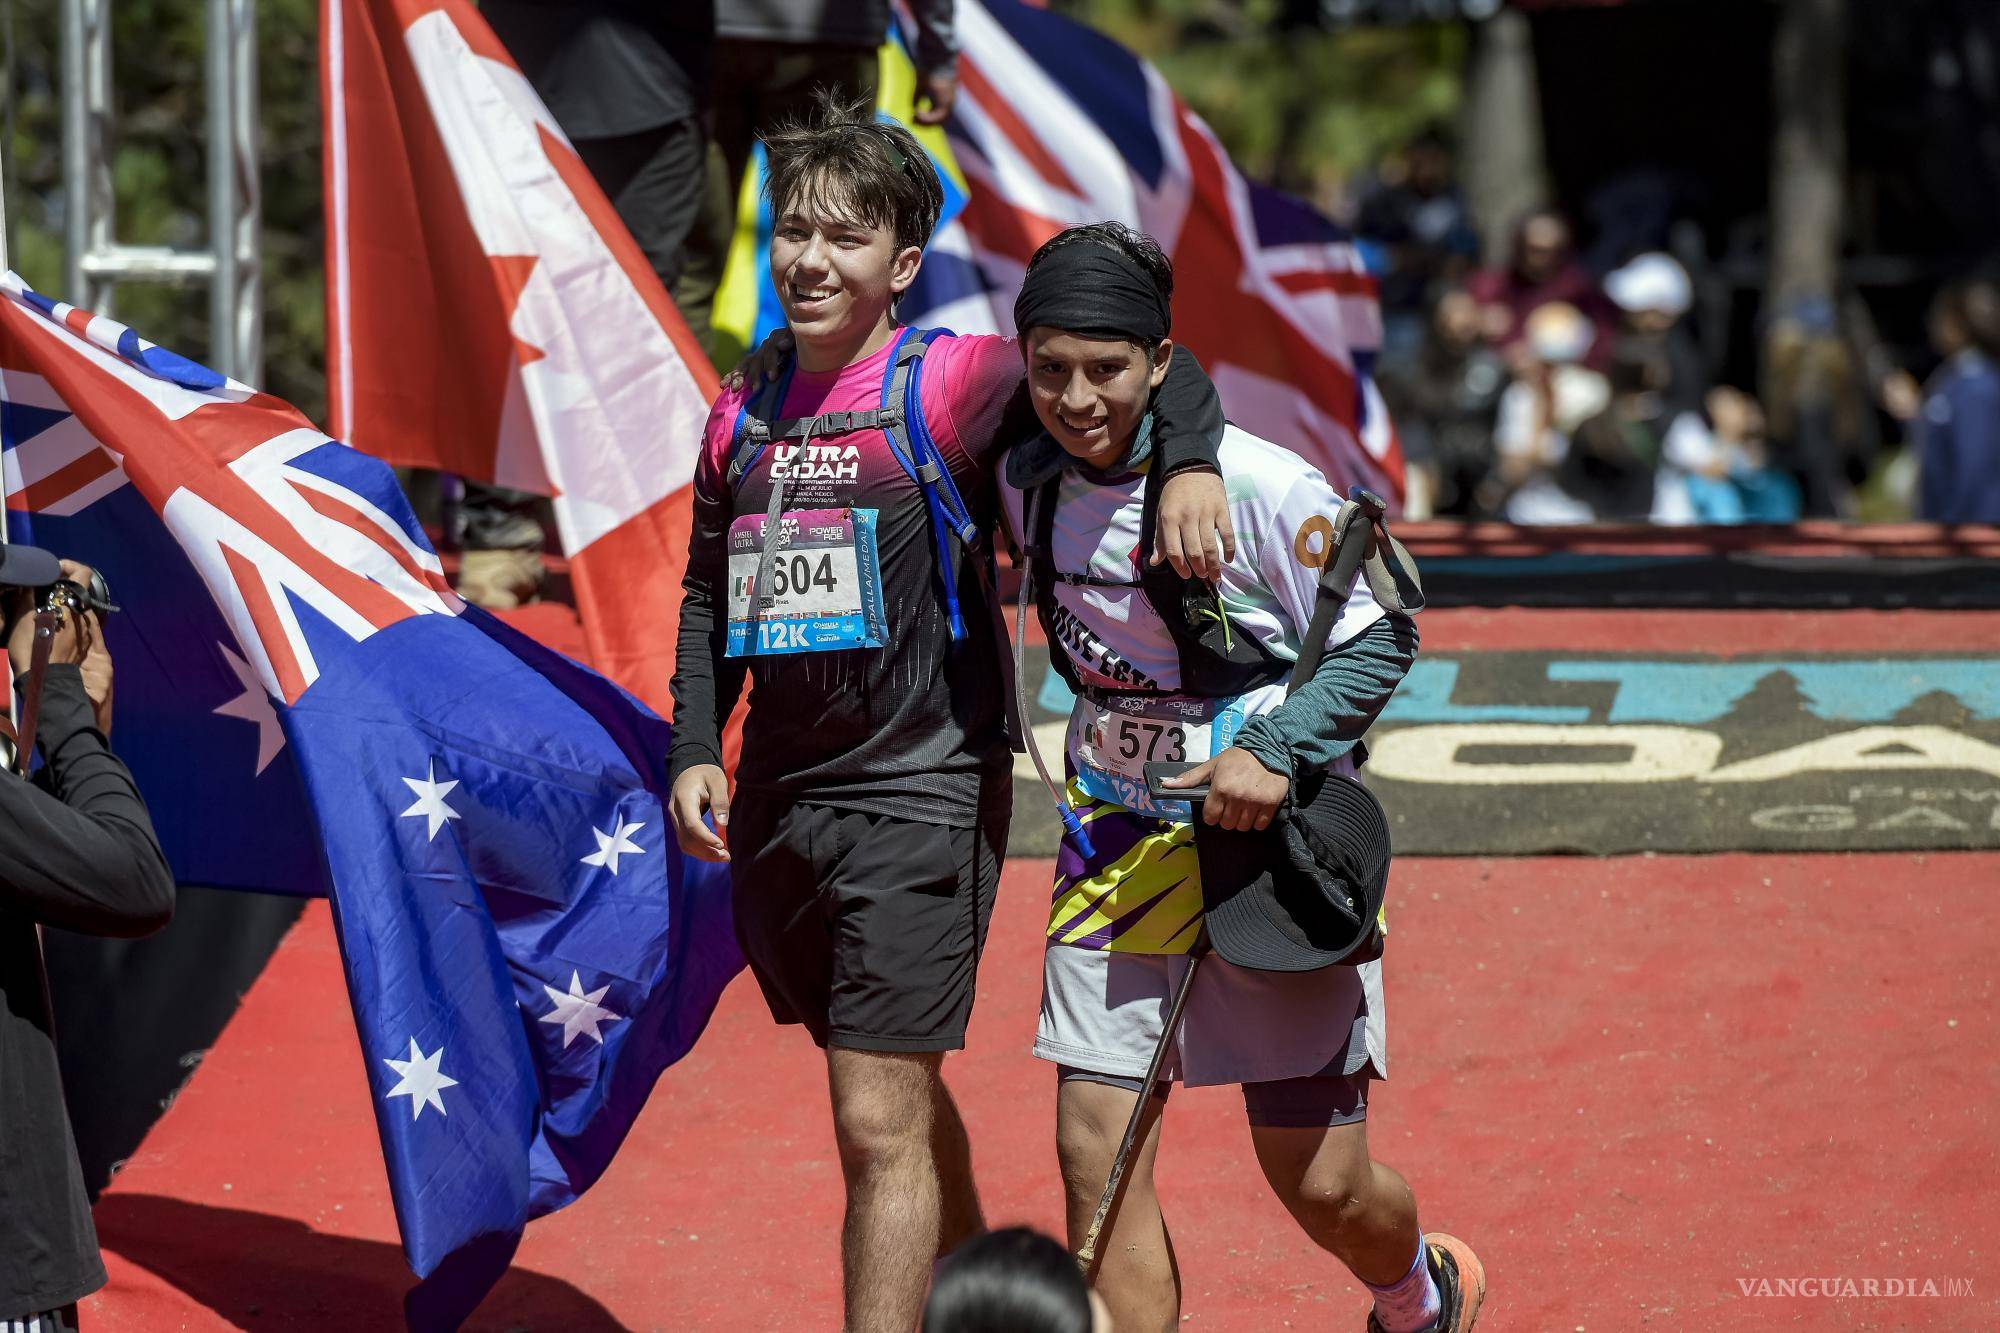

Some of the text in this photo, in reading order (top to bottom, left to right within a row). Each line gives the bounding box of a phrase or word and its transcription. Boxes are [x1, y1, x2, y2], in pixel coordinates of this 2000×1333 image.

[773, 445, 860, 461] UTRA
[770, 461, 858, 478] COAH
[734, 530, 752, 539] AMSTEL
[760, 526, 800, 537] CAH
[809, 526, 843, 534] POWER
[734, 539, 754, 548] ULTRA
[774, 553, 837, 596] 604
[861, 527, 880, 641] MEDALLA/MEDAL
[759, 622, 810, 649] 12K
[1166, 701, 1203, 711] POWER
[1119, 720, 1186, 762] 573
